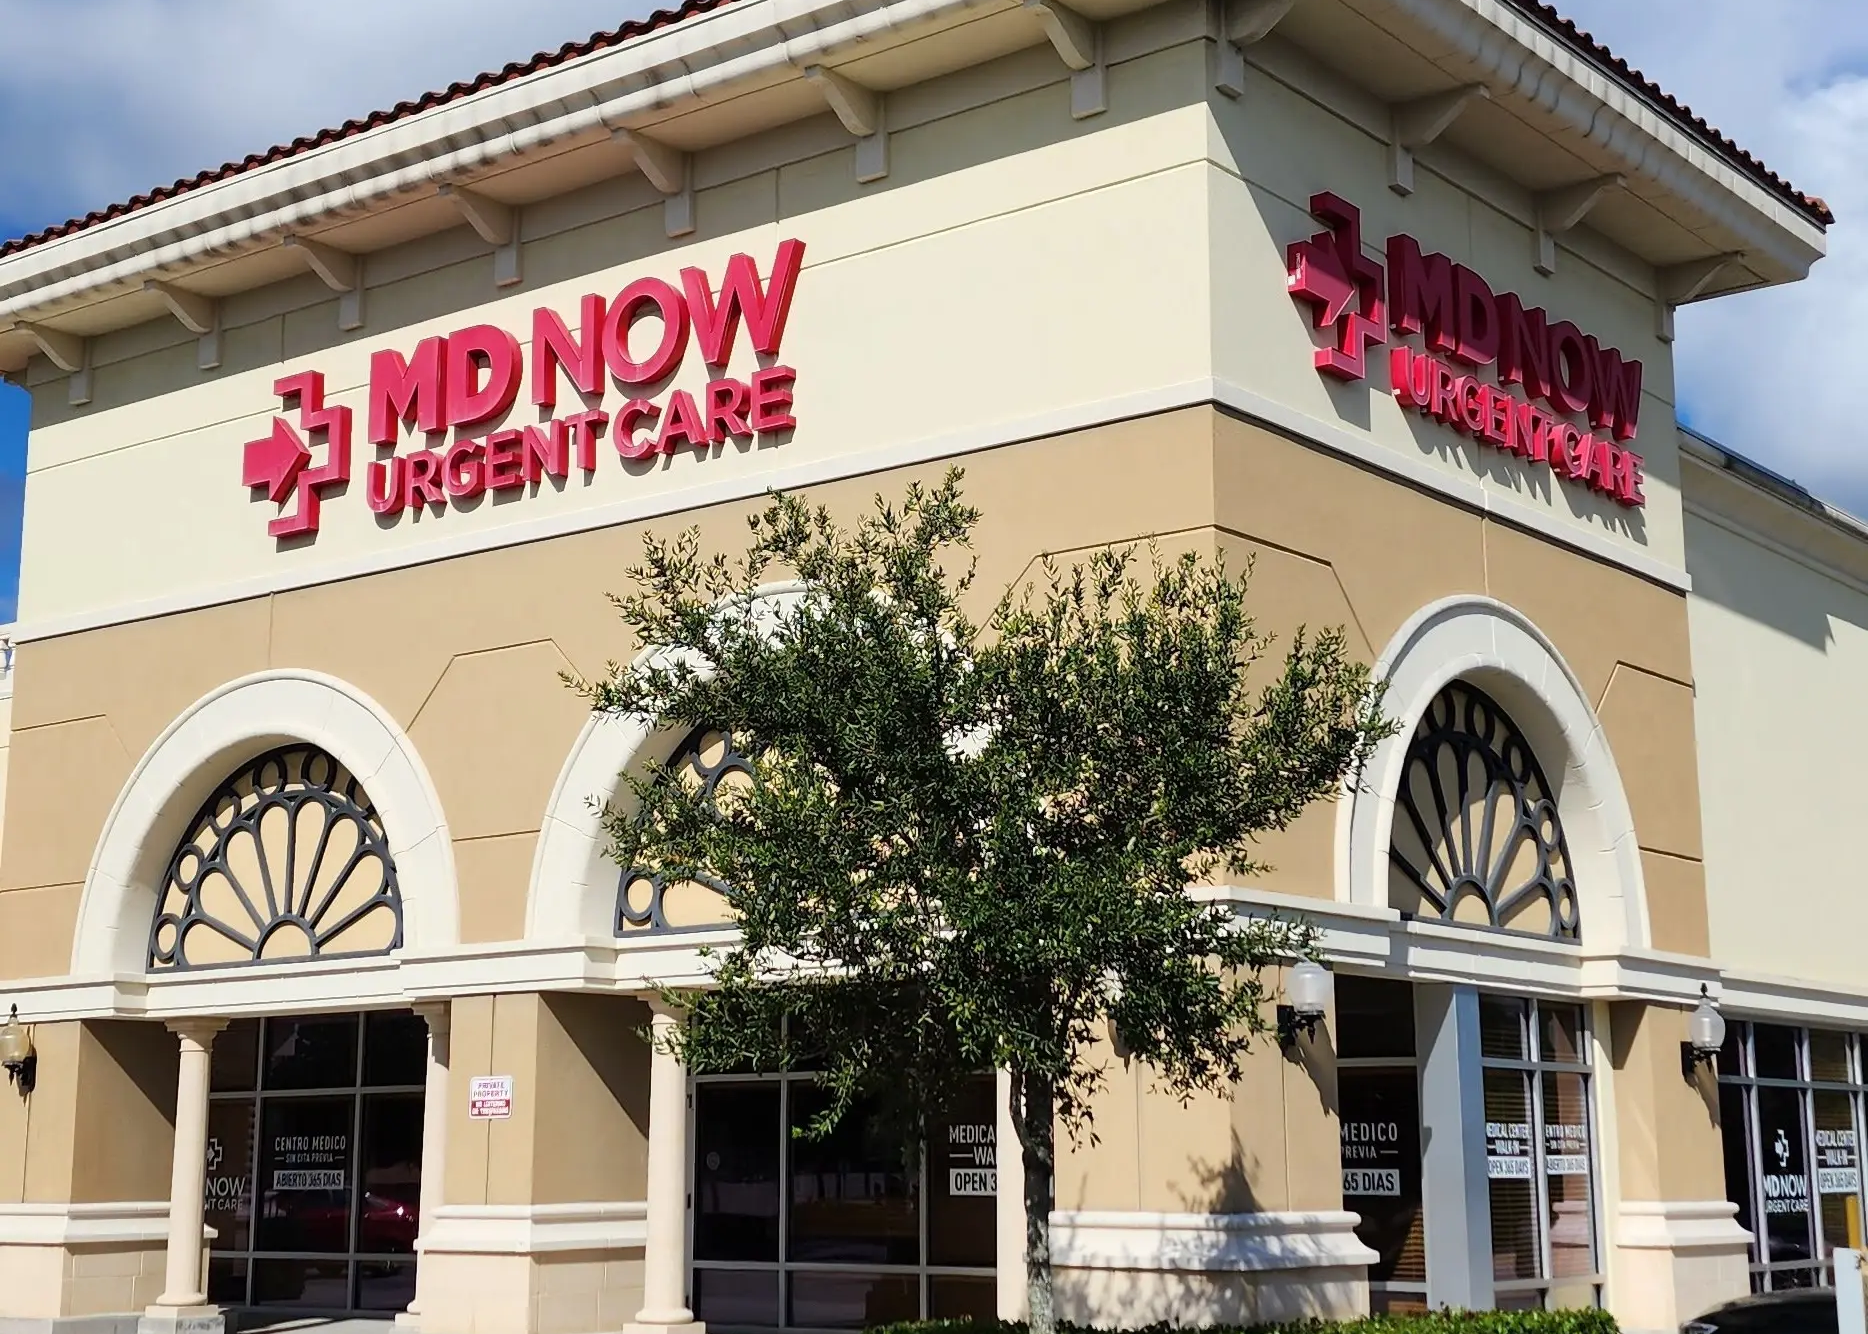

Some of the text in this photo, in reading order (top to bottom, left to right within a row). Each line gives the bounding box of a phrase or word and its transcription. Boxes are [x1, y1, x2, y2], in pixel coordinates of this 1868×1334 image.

[368, 238, 806, 445] MD NOW
[1385, 232, 1643, 441] MD NOW
[1389, 346, 1646, 508] URGENT CARE
[366, 365, 797, 515] URGENT CARE
[473, 1090, 508, 1098] PROPERTY
[275, 1135, 346, 1151] CENTRO MEDICO
[949, 1124, 996, 1144] MEDICA
[973, 1145, 995, 1166] WA
[205, 1177, 246, 1197] NOW
[276, 1172, 341, 1187] ABIERTO 365 DIAS
[954, 1172, 997, 1192] OPEN 3
[1343, 1172, 1395, 1192] 65 DIAS
[1781, 1174, 1807, 1198] NOW
[217, 1198, 243, 1210] CARE
[1791, 1199, 1809, 1213] CARE
